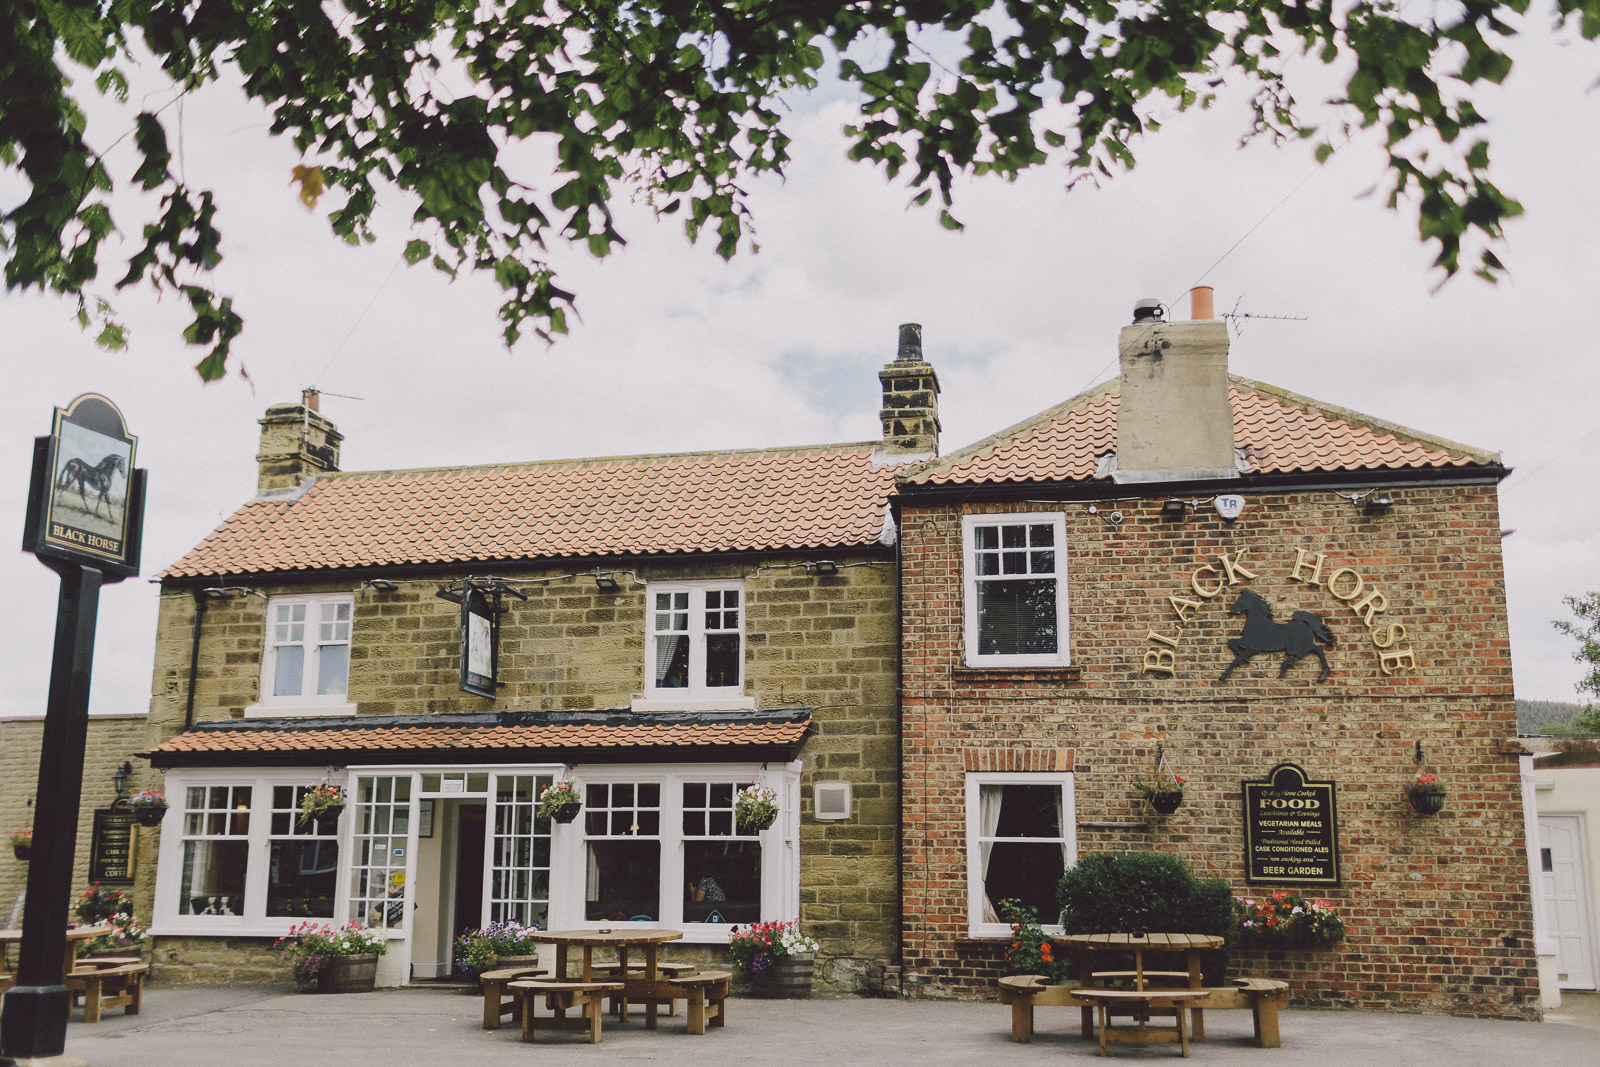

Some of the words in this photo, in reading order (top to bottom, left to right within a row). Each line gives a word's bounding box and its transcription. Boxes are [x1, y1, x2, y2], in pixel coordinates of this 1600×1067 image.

[1221, 498, 1238, 508] TR
[53, 525, 86, 543] BLACK
[87, 535, 119, 552] HORSE
[1142, 547, 1259, 678] BLACK
[1287, 547, 1417, 676] HORSE
[1260, 799, 1320, 808] FOOD
[1280, 855, 1302, 864] smoking
[1263, 866, 1285, 874] BEER
[1287, 867, 1324, 875] GARDEN
